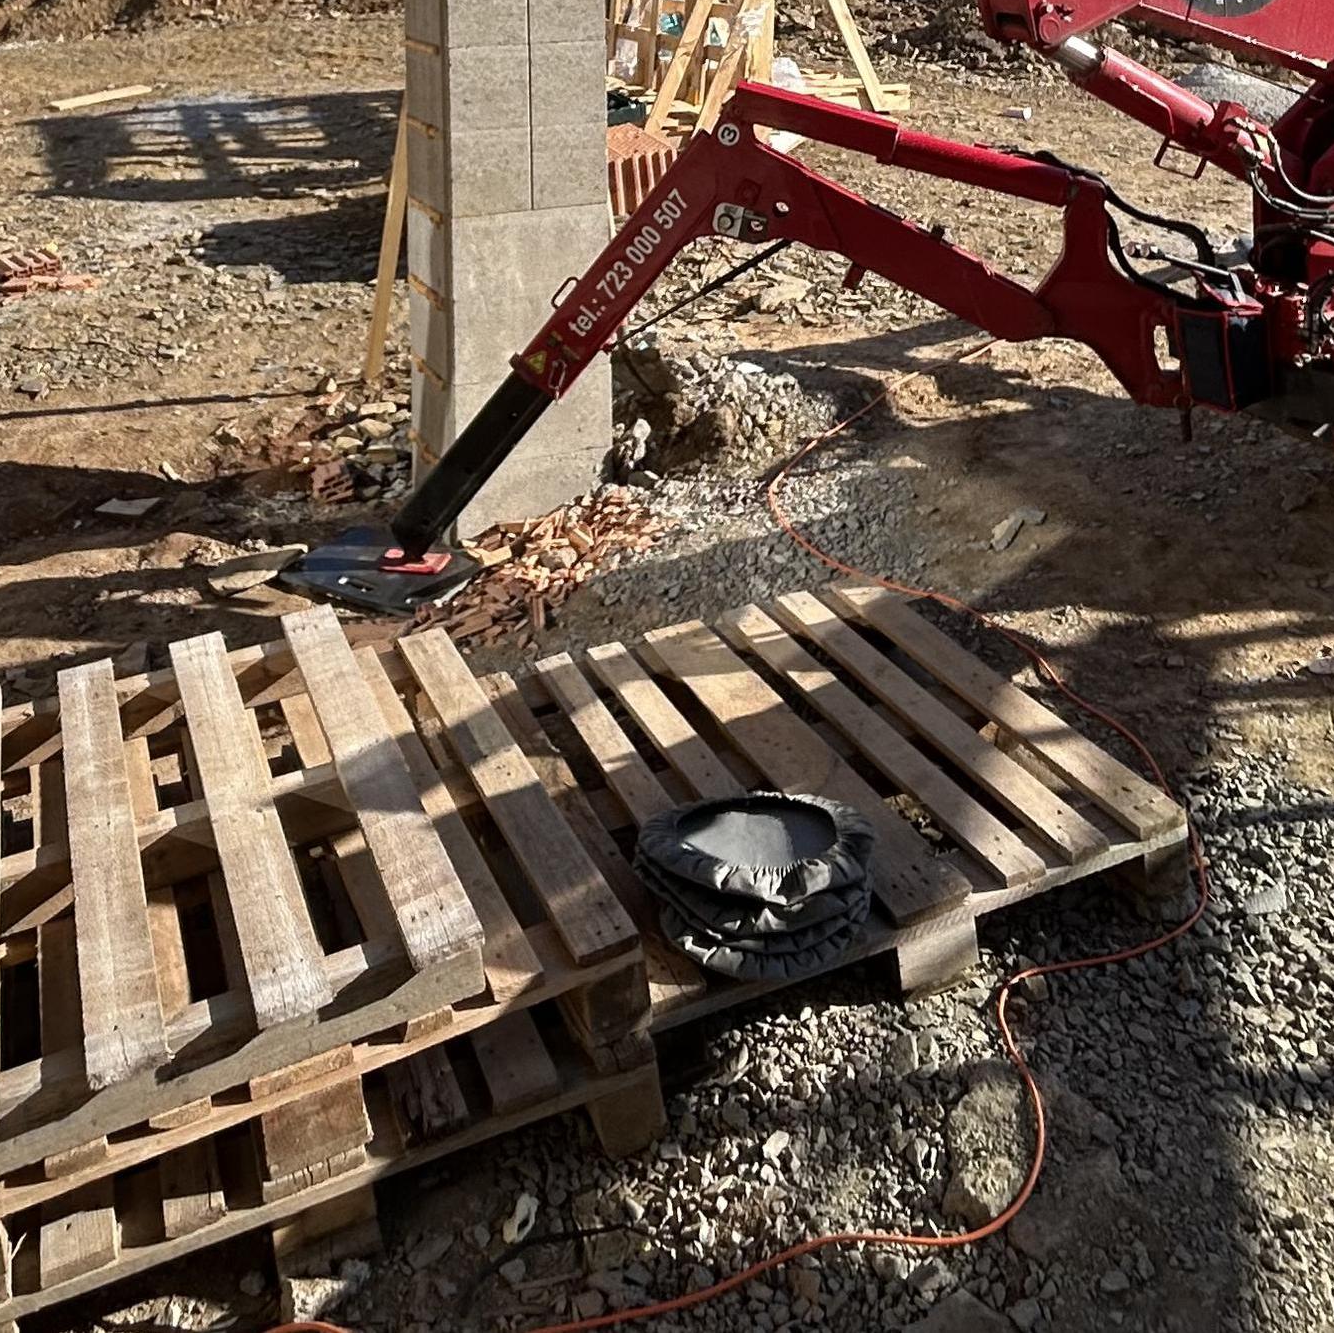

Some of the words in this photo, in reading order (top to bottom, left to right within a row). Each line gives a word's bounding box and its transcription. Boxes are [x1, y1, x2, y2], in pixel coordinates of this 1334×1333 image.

[721, 126, 738, 143] 3
[568, 298, 606, 337] tel.:
[596, 261, 633, 299] 723
[625, 225, 662, 264] 000
[653, 188, 688, 229] 507
